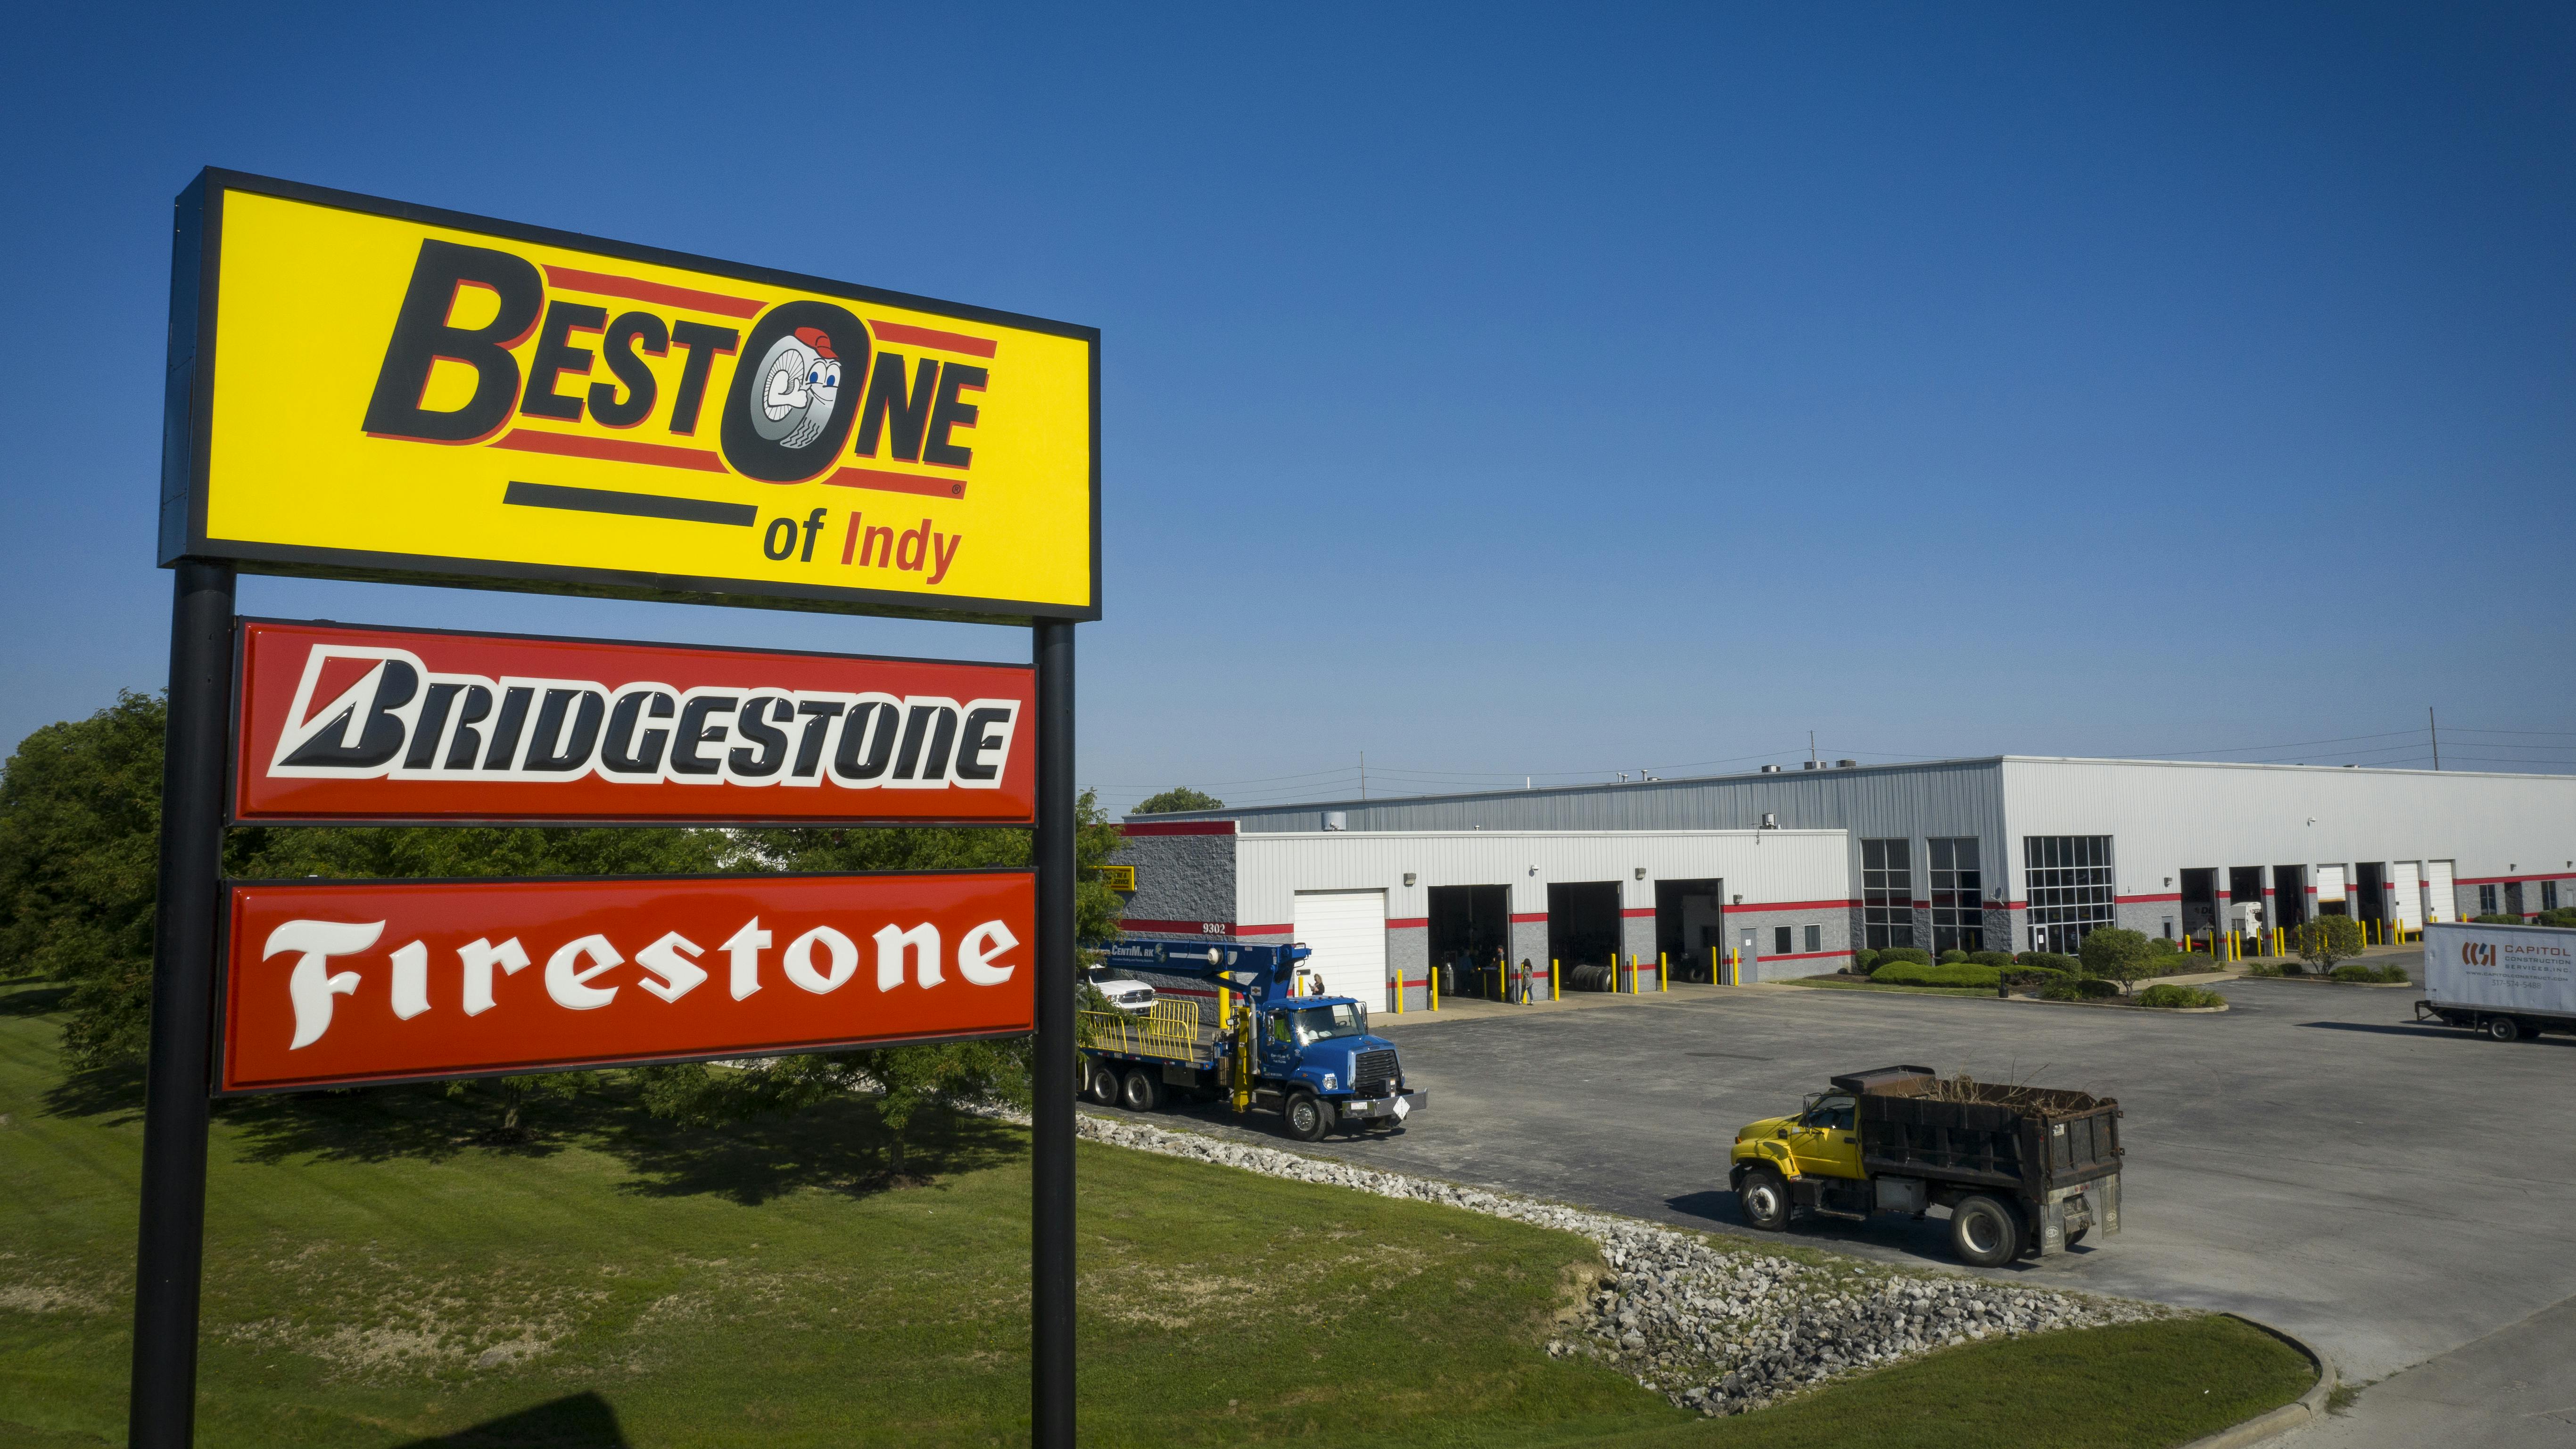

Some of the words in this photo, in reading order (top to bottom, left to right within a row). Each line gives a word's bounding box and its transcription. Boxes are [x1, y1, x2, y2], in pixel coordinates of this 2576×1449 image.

[762, 507, 828, 563] of
[841, 511, 962, 585] Indy
[267, 644, 1021, 790] BRIDGESTONE
[1203, 923, 1225, 934] 9302
[2504, 945, 2571, 956] CAPITOL
[2504, 956, 2571, 965] CONSTRUCTION
[263, 916, 1020, 1051] Firestone
[2491, 980, 2542, 989] 317-574-5488
